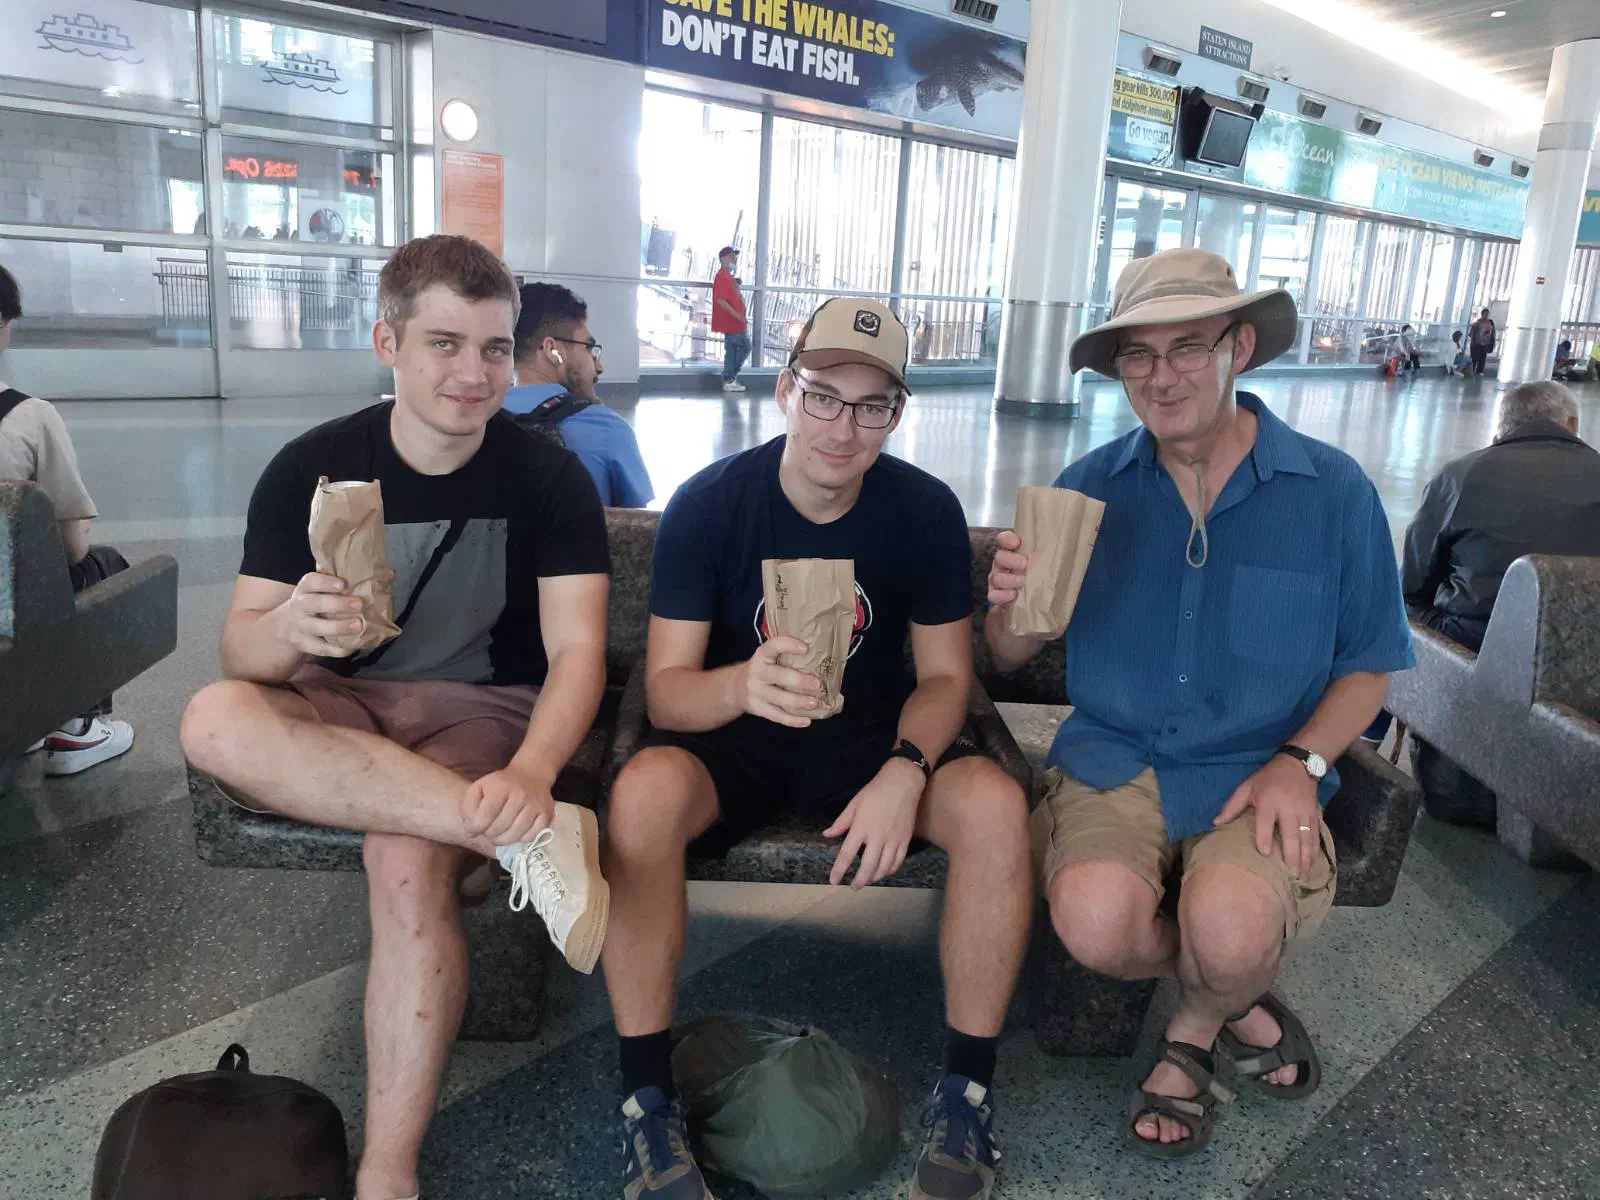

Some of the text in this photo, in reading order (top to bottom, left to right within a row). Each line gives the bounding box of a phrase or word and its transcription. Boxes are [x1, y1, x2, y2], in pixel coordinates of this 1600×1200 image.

[742, 0, 895, 57] THE WHALES:
[662, 9, 860, 86] DON'T EAT FISH.
[1201, 31, 1251, 54] STATEN ISLAND
[1204, 44, 1248, 65] ATTRACTIONS
[1122, 80, 1136, 93] gear
[1137, 83, 1149, 96] kills
[1129, 121, 1141, 138] Go
[1289, 126, 1336, 166] Ocean
